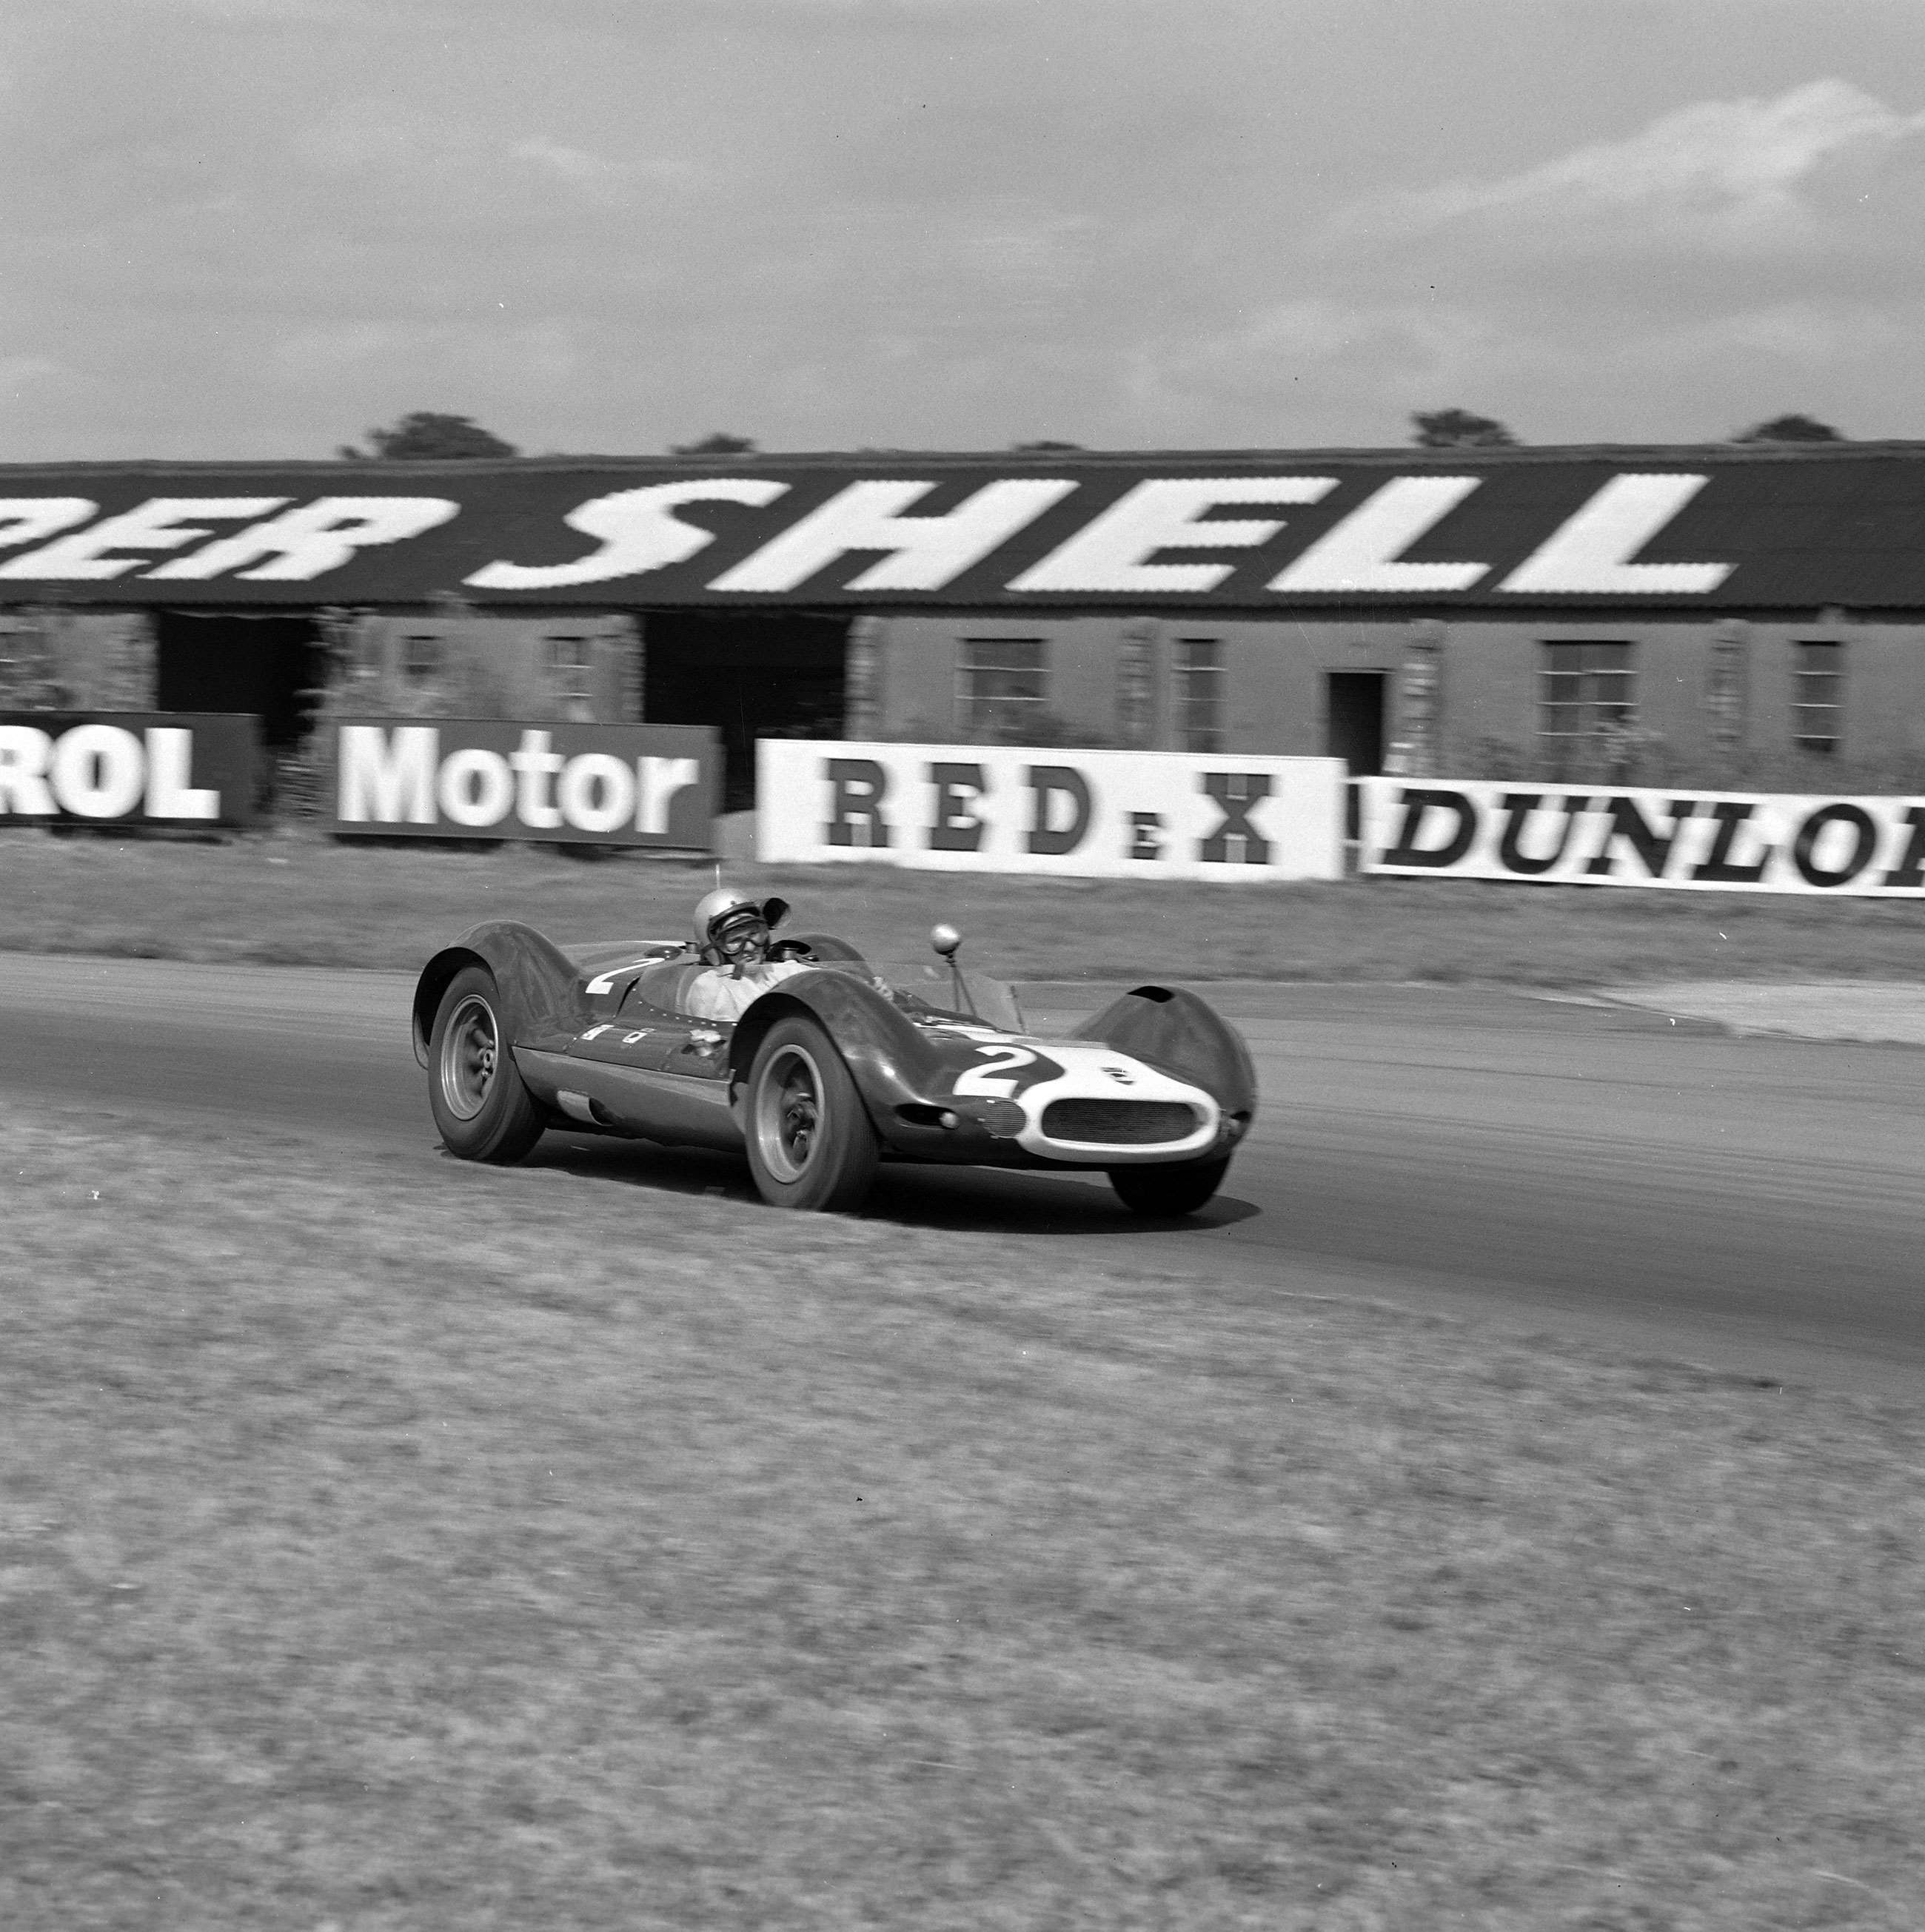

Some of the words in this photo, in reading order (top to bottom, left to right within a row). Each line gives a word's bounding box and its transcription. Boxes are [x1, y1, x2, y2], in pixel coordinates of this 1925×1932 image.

[461, 473, 1733, 593] SHELL
[0, 724, 221, 819] ROL
[337, 725, 700, 834] Motor
[584, 957, 666, 995] 2
[952, 1045, 1037, 1099] 2
